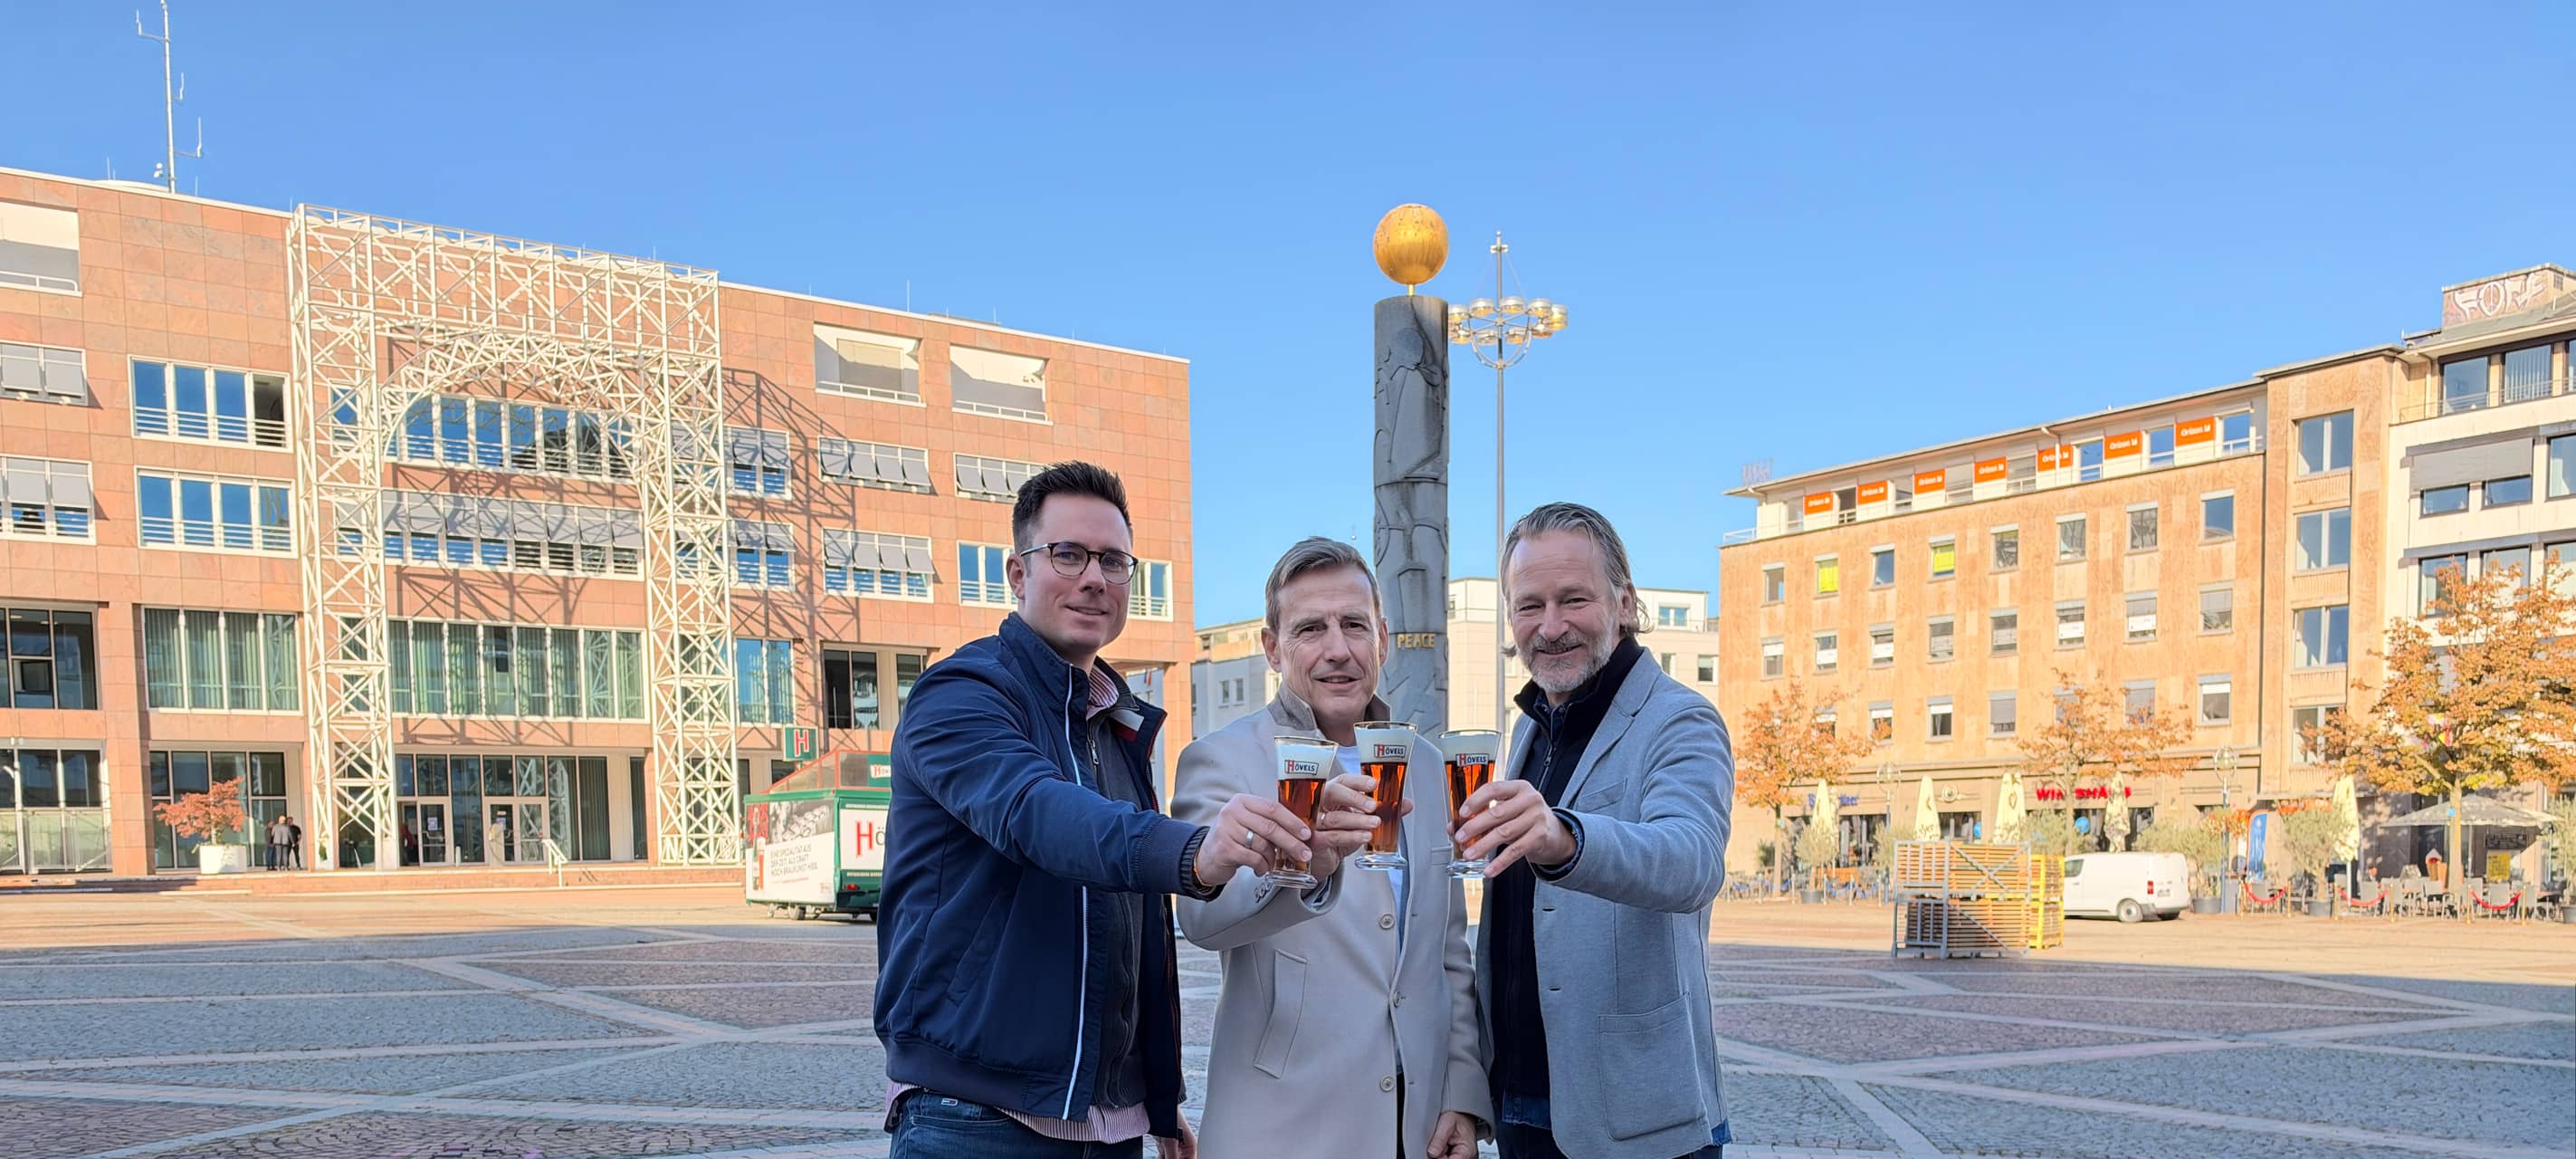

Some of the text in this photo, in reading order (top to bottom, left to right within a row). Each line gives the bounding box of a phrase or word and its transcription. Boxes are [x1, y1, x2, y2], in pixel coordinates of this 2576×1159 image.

[1397, 633, 1435, 649] PEACE
[794, 729, 809, 757] H
[1377, 743, 1405, 758] HÖVELS
[1287, 759, 1316, 774] HÖVELS
[1458, 752, 1487, 767] HÖVELS
